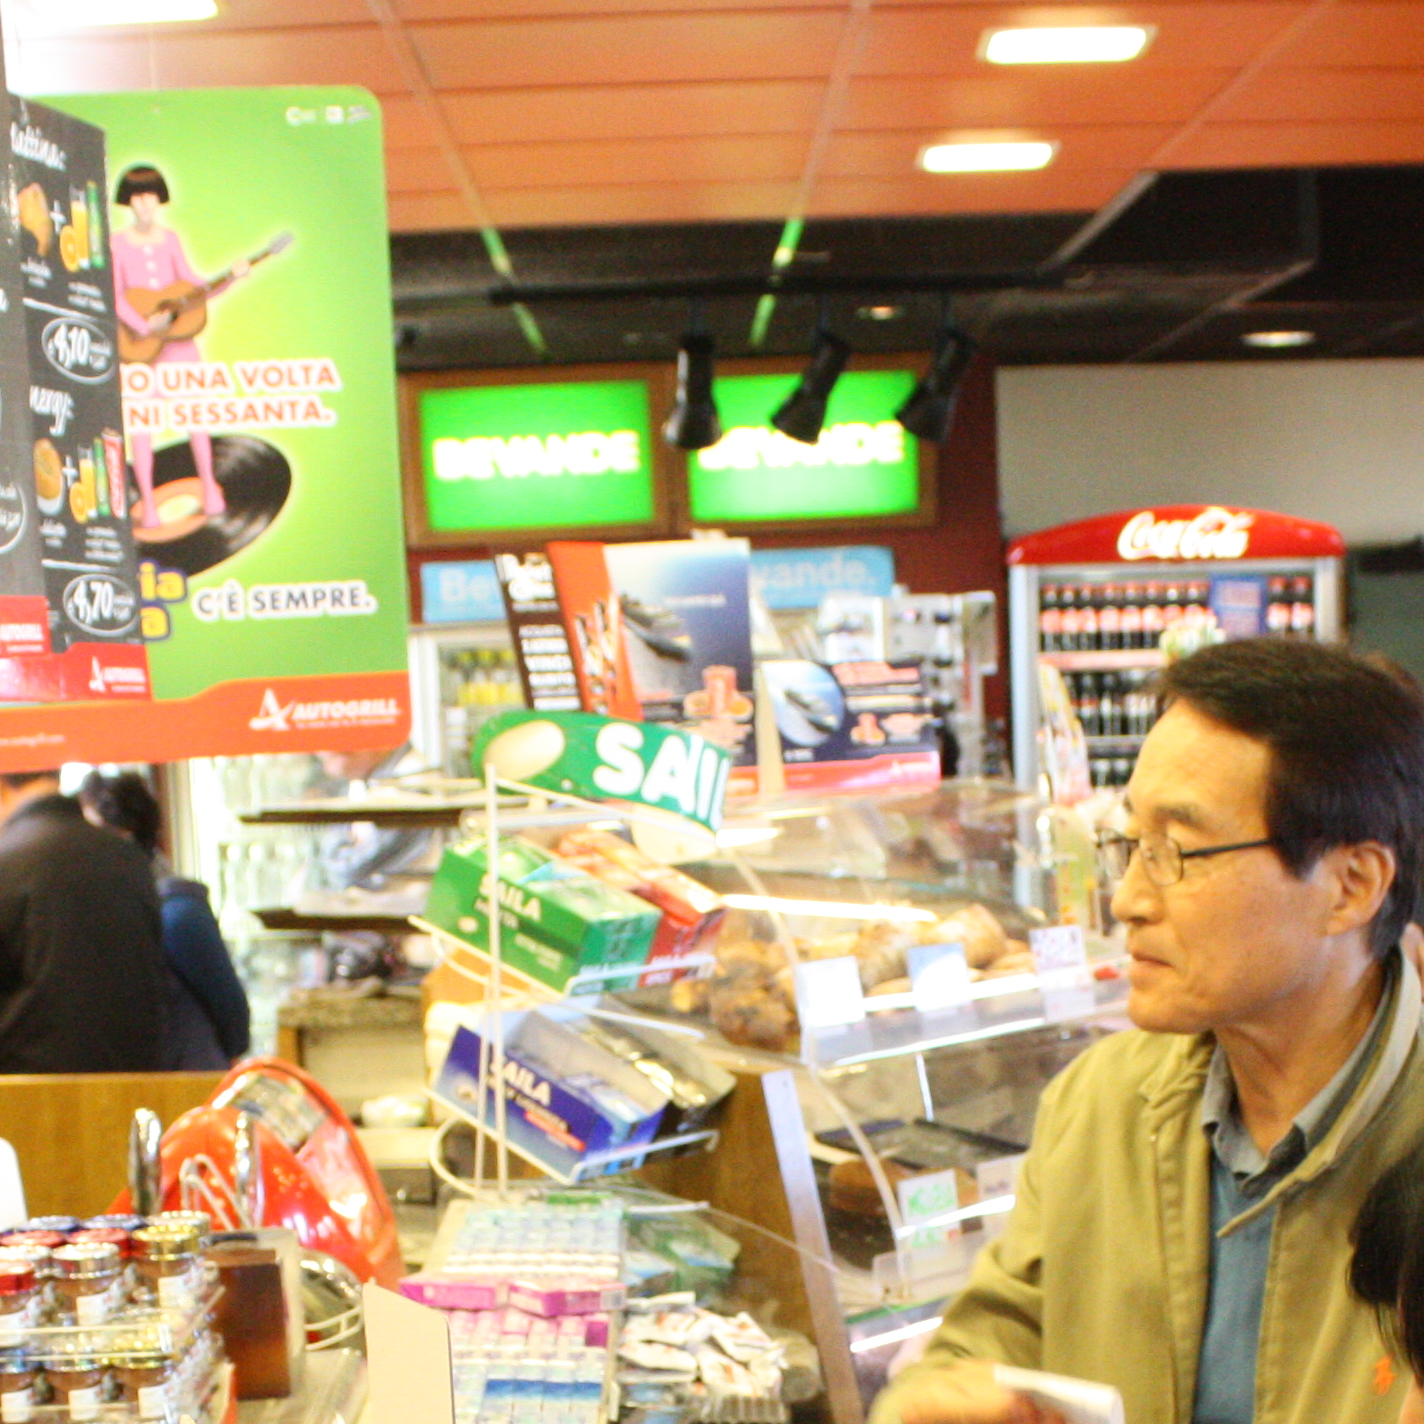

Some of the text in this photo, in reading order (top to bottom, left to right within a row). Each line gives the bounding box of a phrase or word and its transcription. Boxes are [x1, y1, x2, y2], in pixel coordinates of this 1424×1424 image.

[162, 363, 336, 391] UNA VOLTA
[30, 385, 75, 436] nergy:
[174, 399, 332, 425] SESSANTA.
[432, 430, 641, 481] BEVANDE
[252, 586, 371, 612] SEMPRE.
[292, 698, 398, 721] AUTOGRILL
